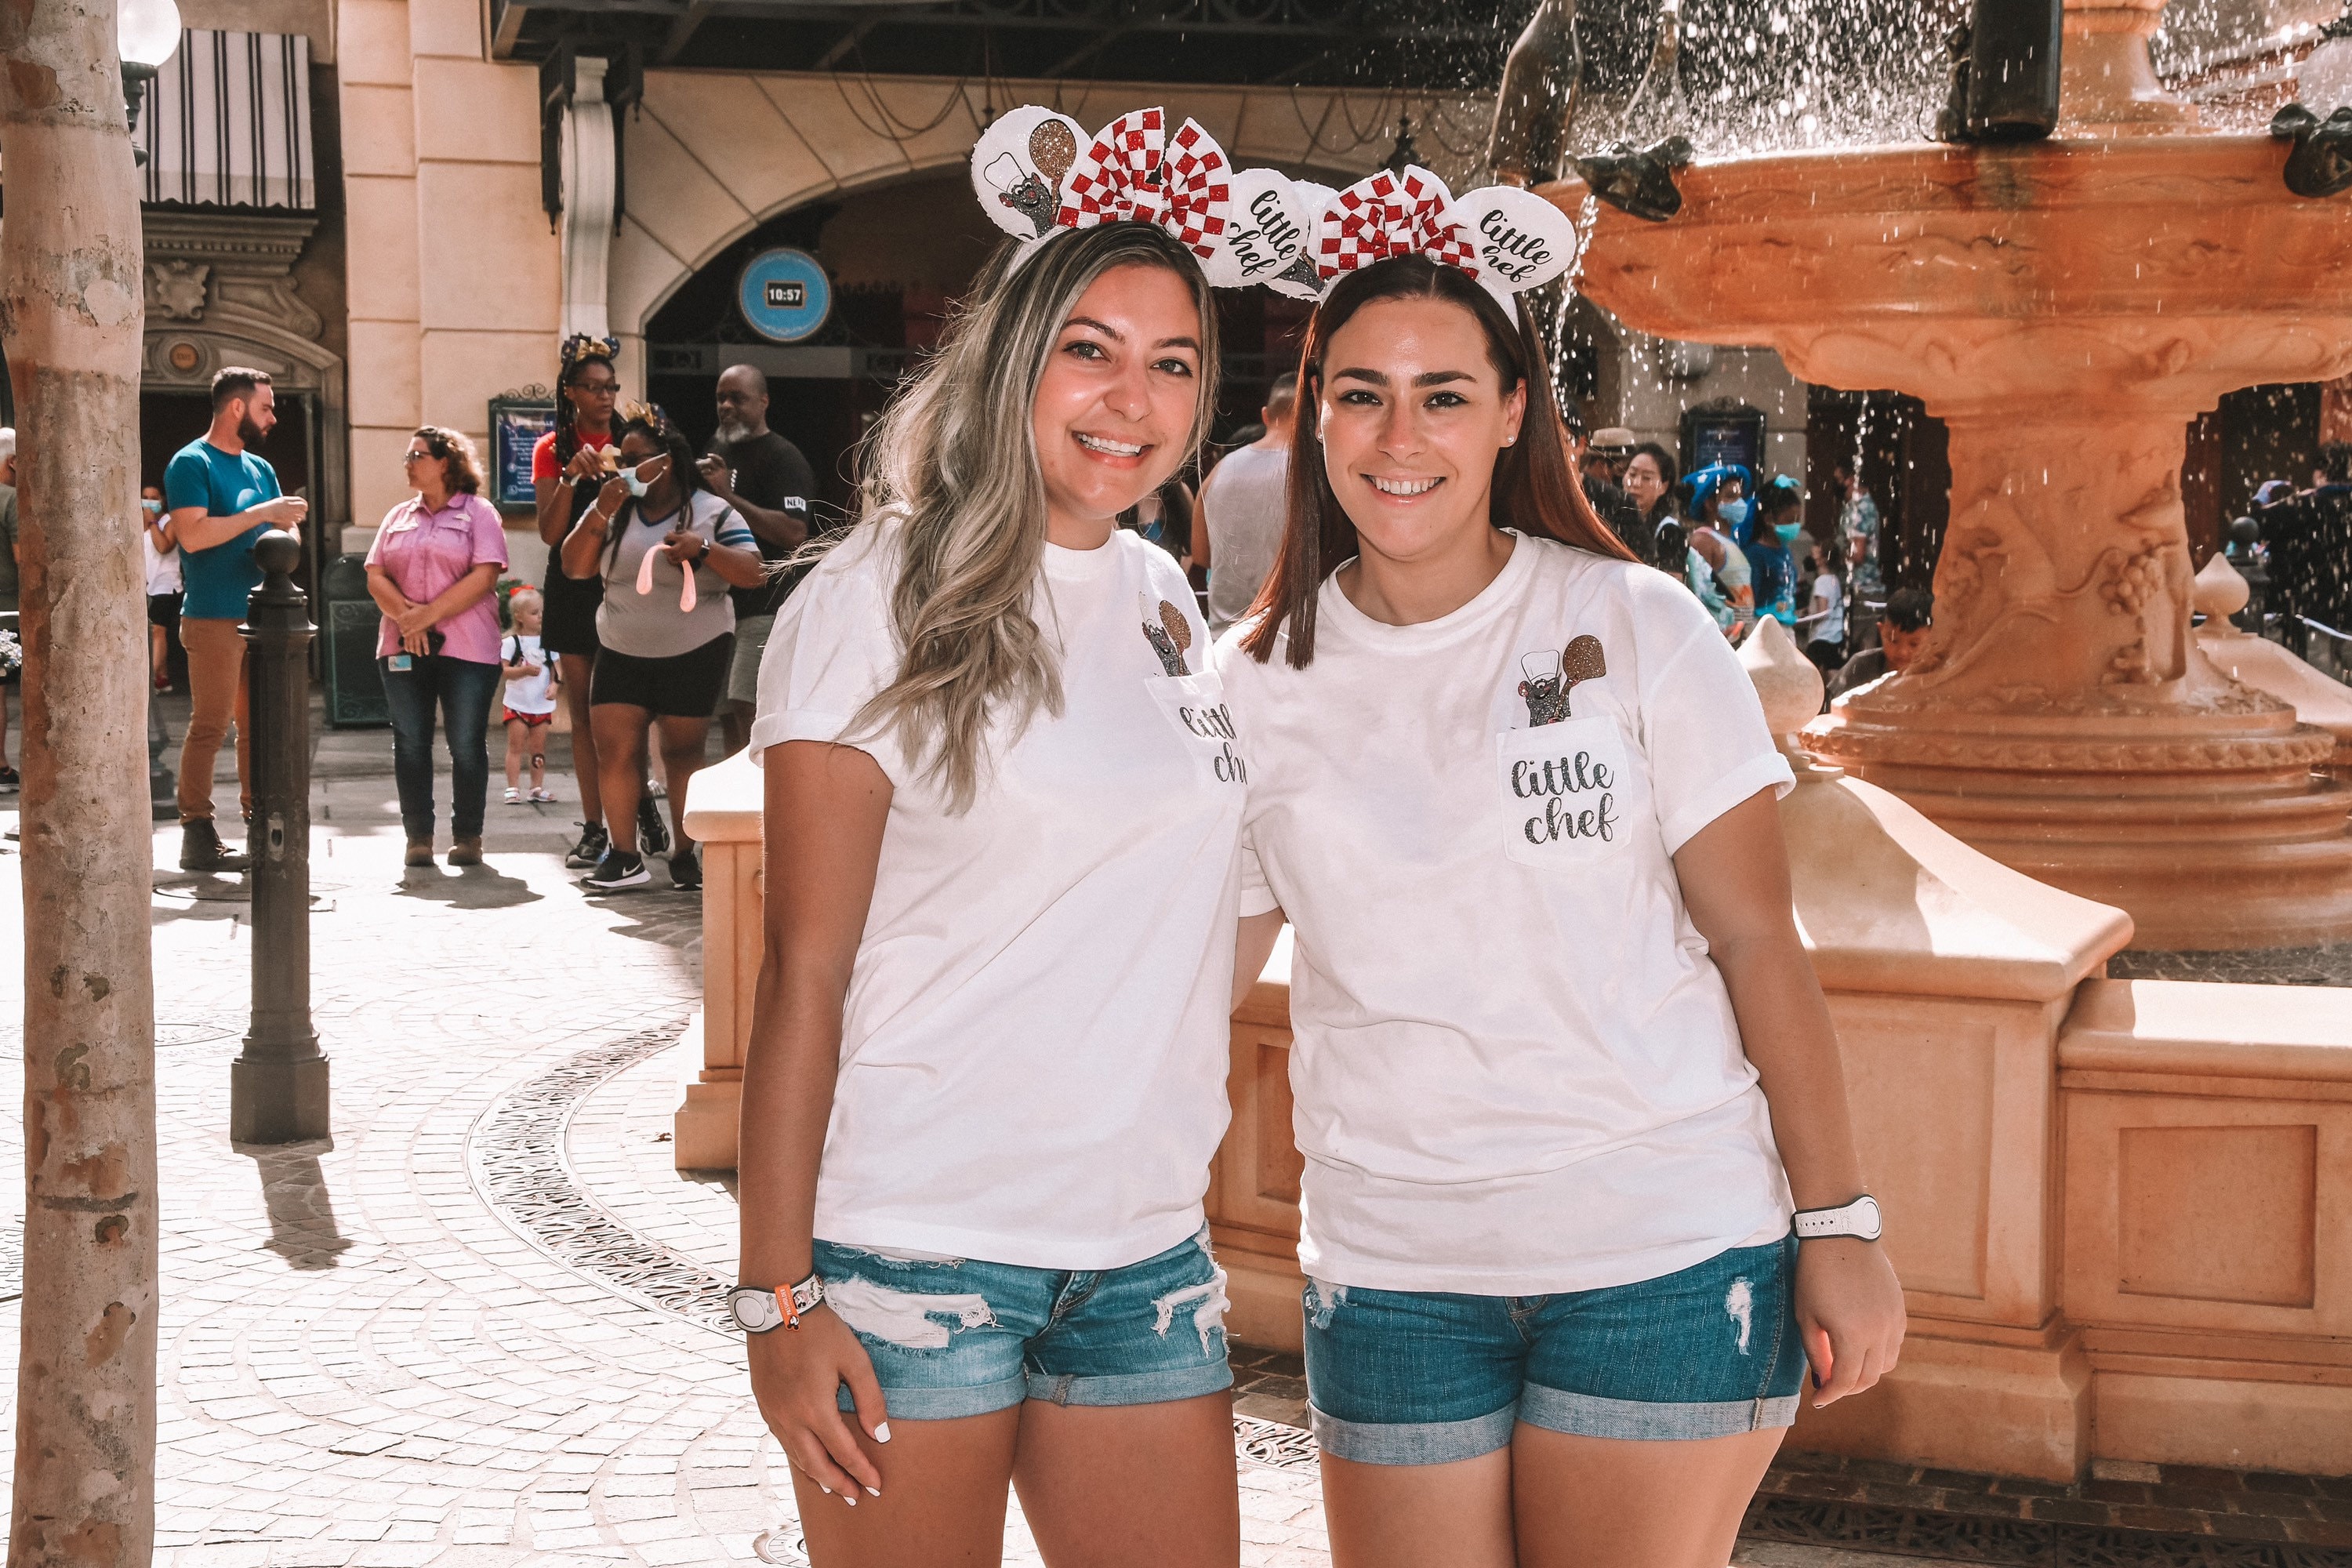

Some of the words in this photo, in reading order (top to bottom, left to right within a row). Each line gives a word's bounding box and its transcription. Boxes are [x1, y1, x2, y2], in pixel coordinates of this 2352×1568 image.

[1250, 191, 1300, 260] little
[1480, 209, 1553, 264] little
[1482, 245, 1537, 283] hef
[769, 289, 801, 301] 10:57
[1179, 703, 1237, 739] littl
[1214, 742, 1247, 785] ch
[1511, 751, 1614, 798] little
[1524, 793, 1619, 844] chef
